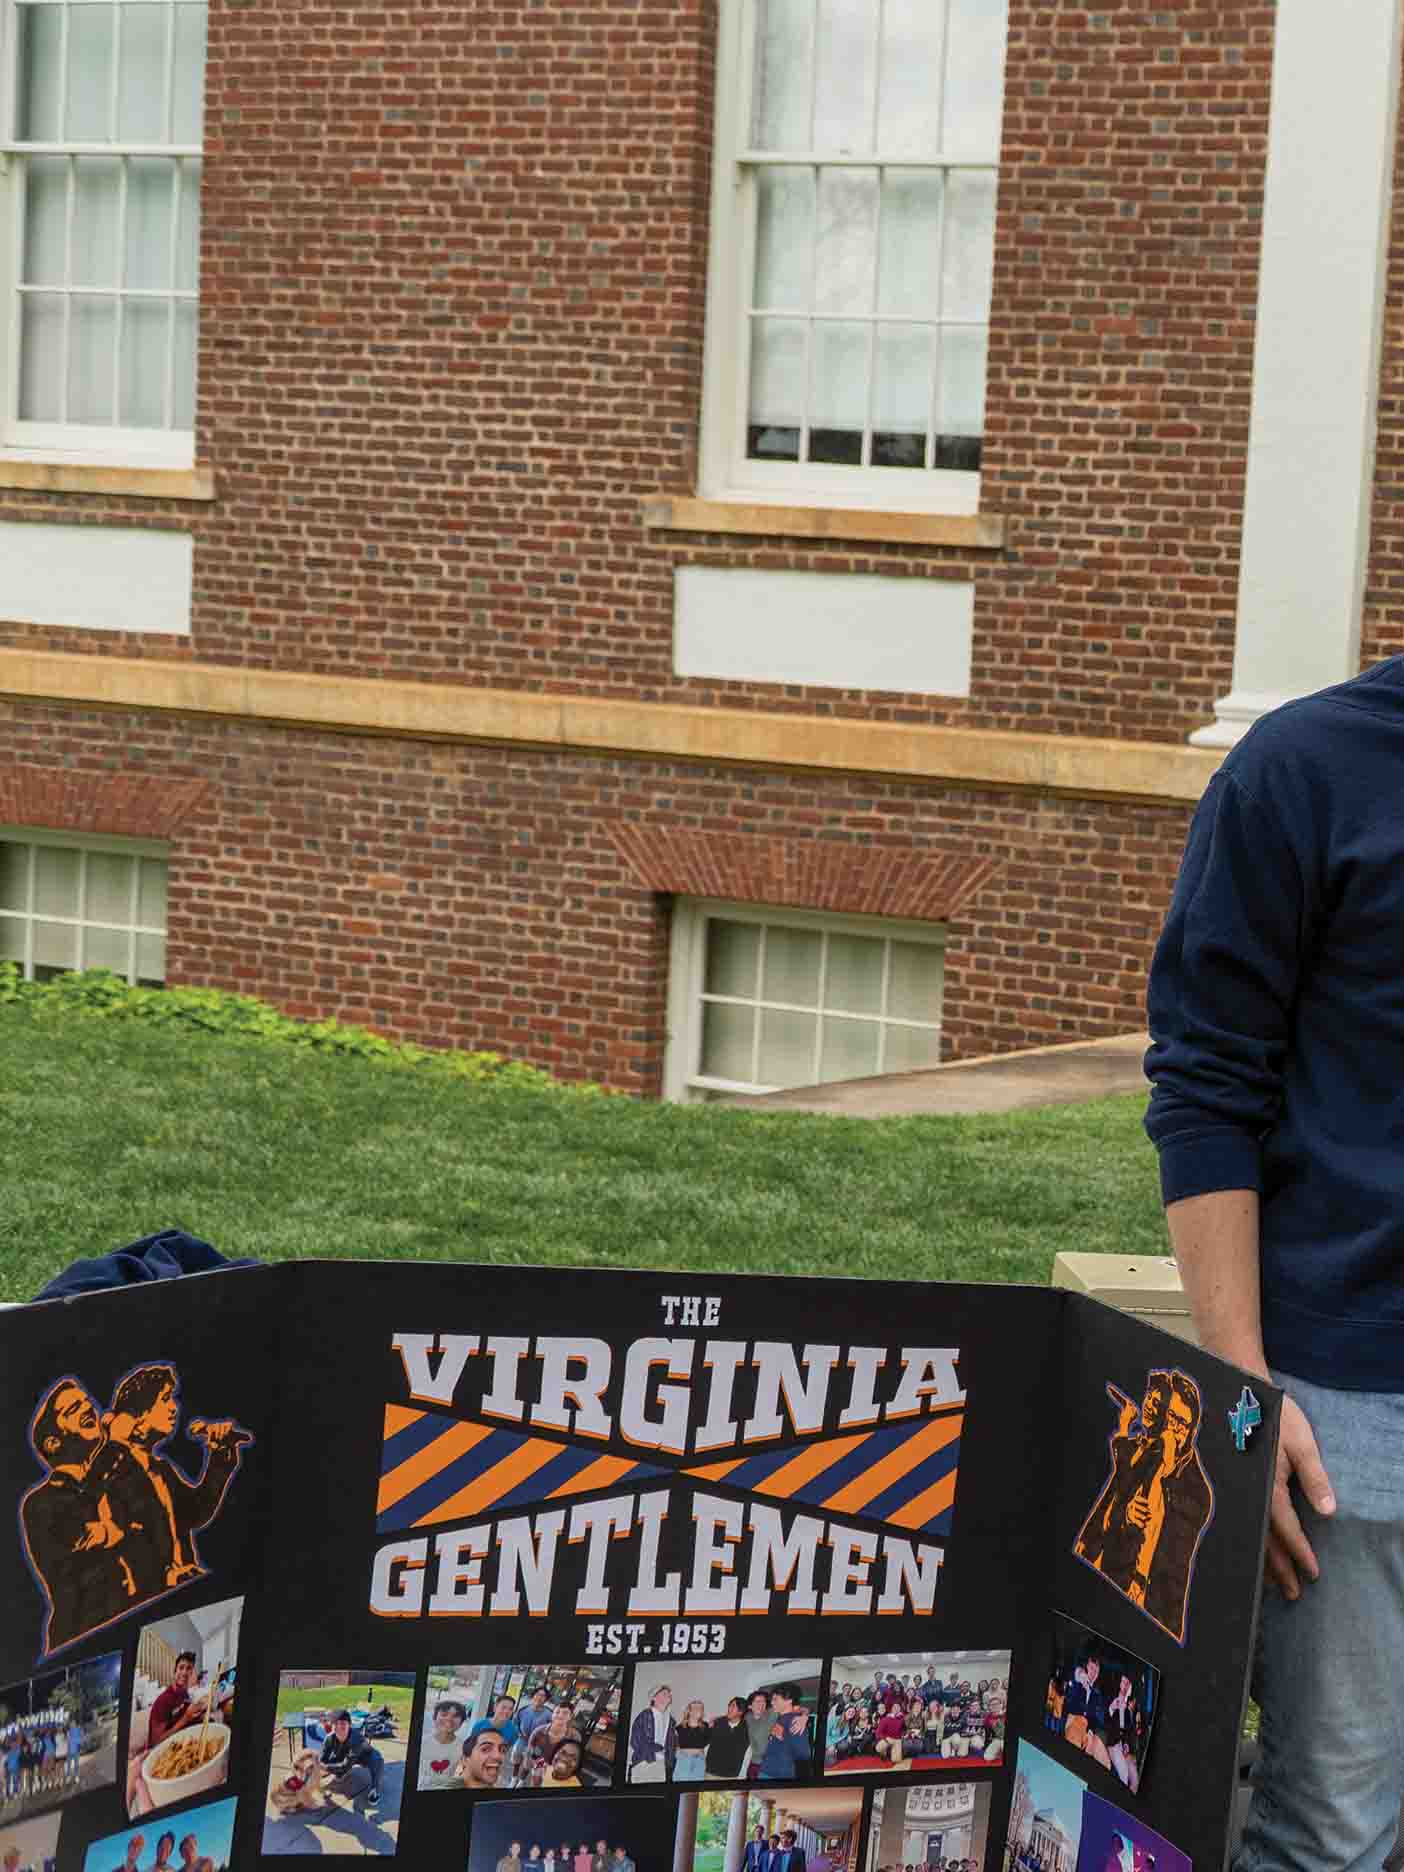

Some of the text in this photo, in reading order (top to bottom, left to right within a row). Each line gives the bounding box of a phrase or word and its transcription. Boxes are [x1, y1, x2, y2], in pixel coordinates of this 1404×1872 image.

[660, 1295, 722, 1327] THE
[392, 1333, 968, 1456] VIRGINIA
[369, 1489, 945, 1617] GENTLEMEN
[659, 1623, 727, 1654] 1953
